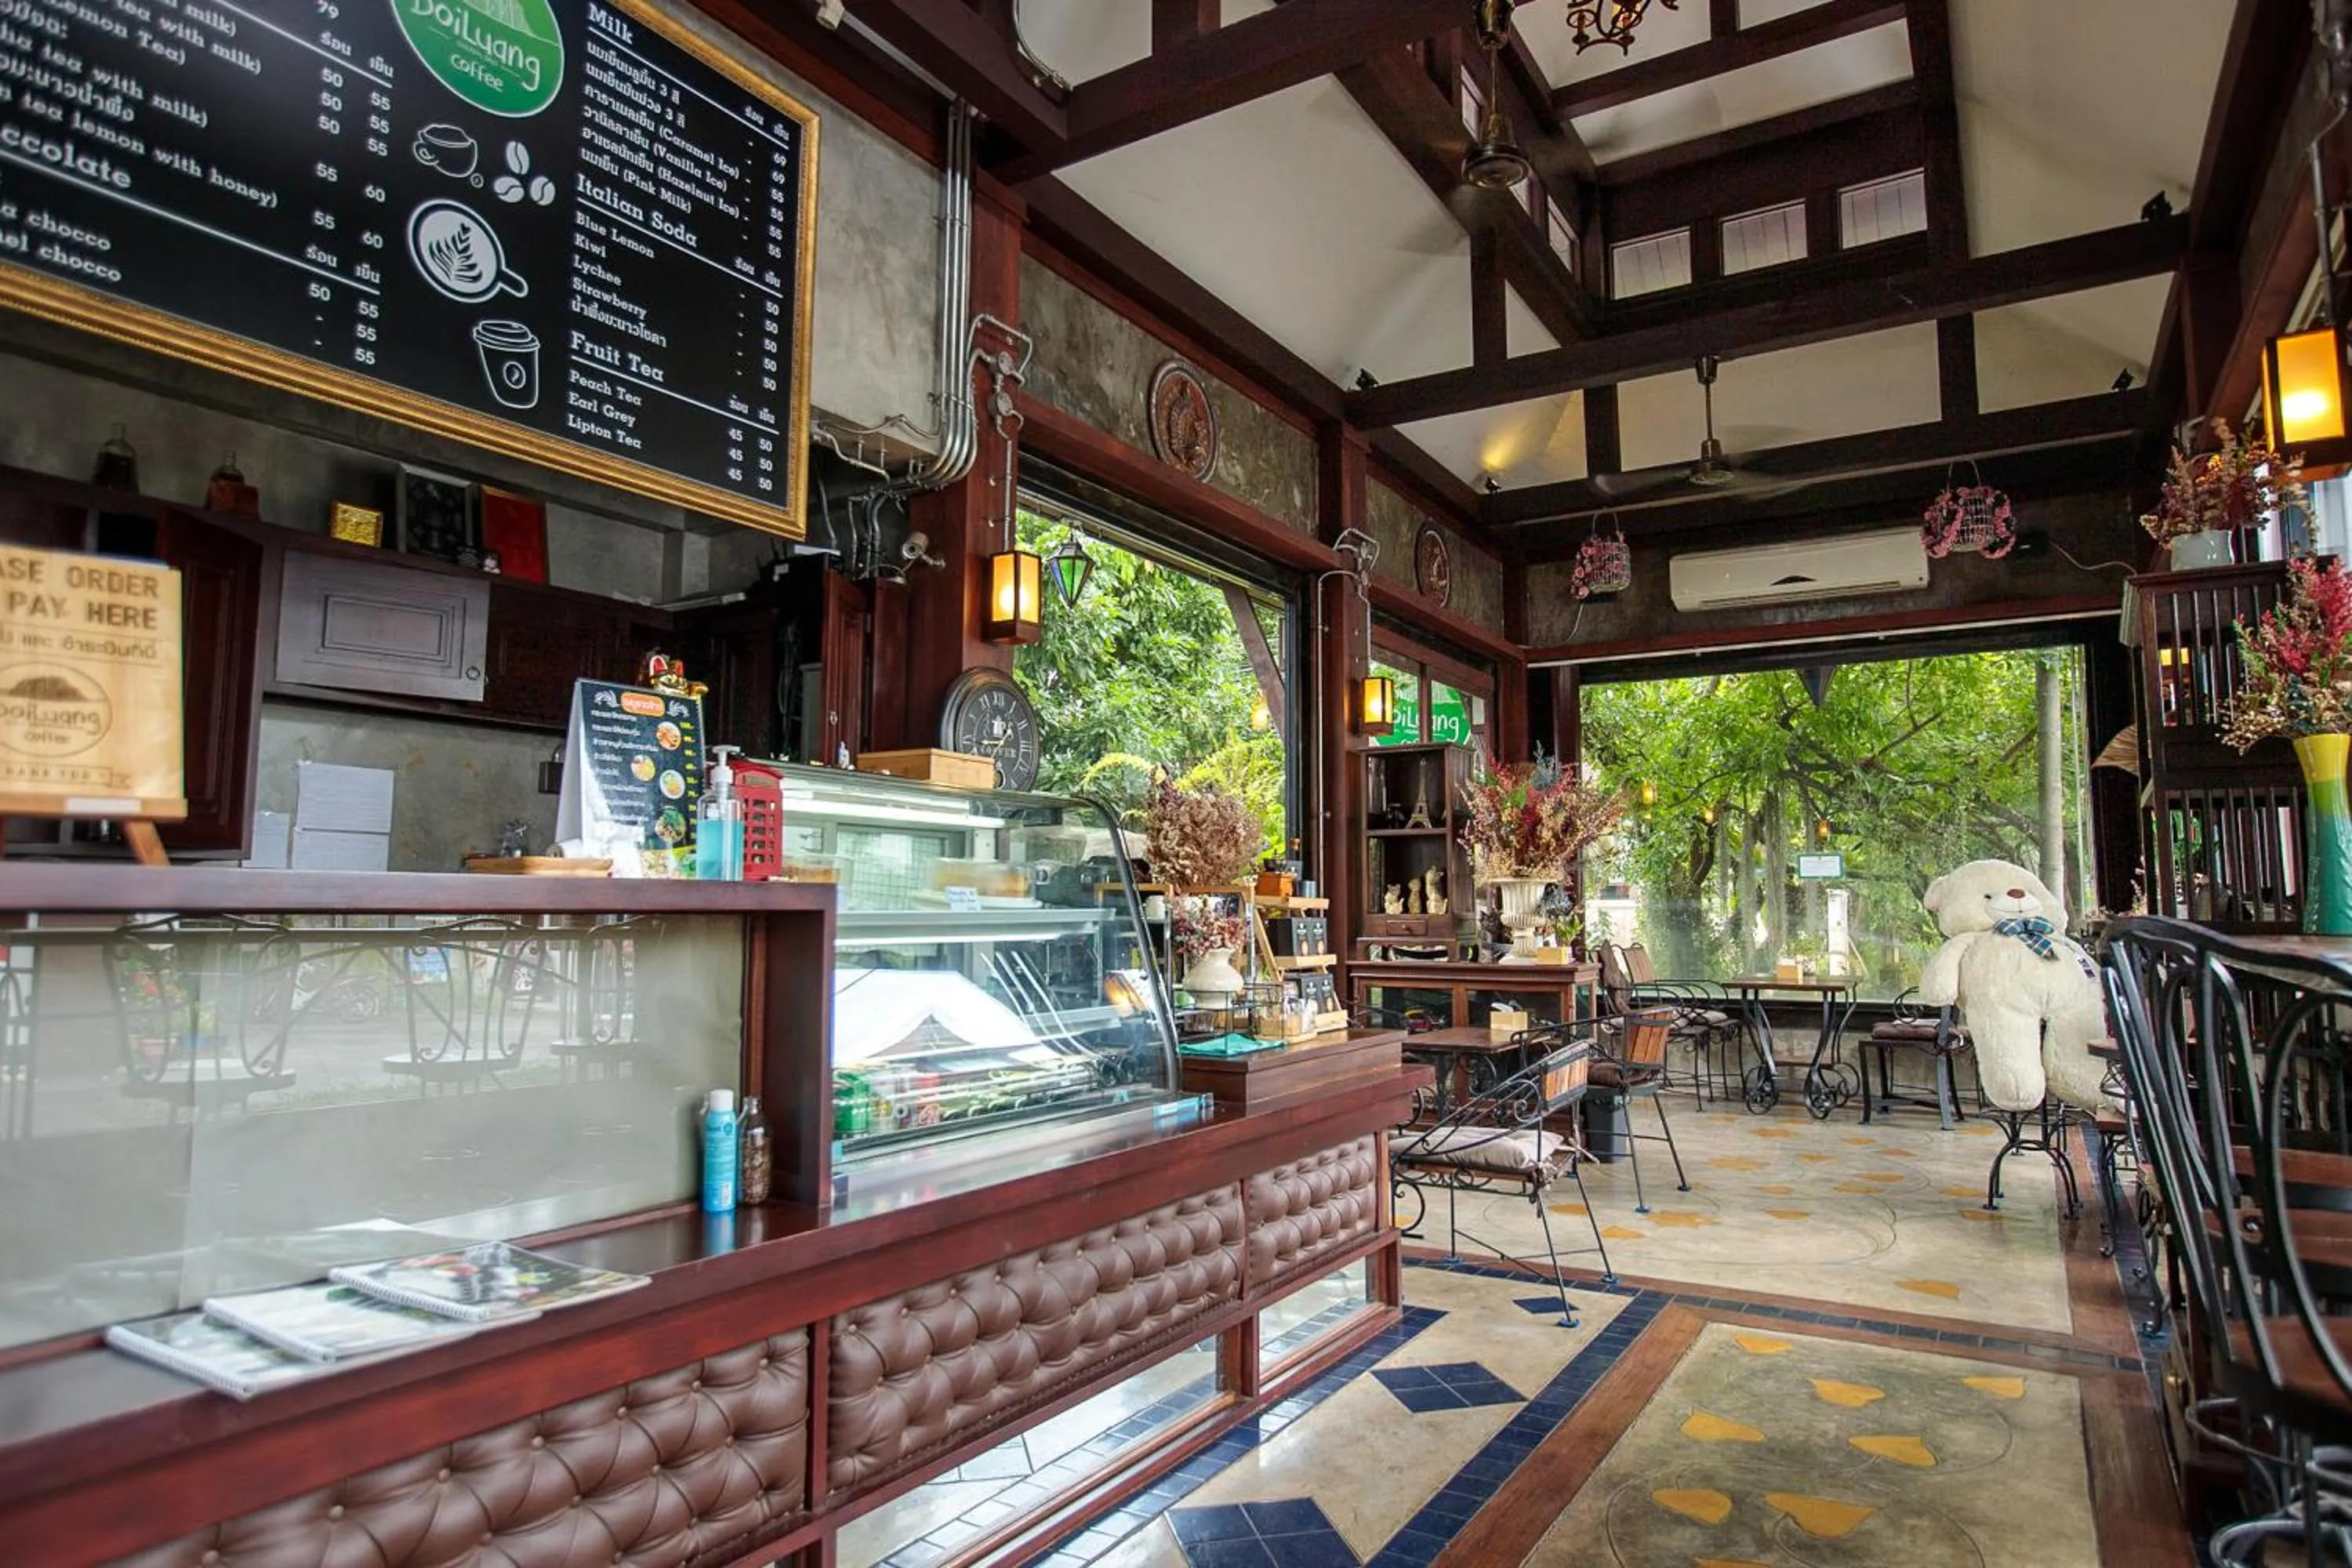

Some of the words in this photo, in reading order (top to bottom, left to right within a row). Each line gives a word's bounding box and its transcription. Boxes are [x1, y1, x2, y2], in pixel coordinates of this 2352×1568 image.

[184, 4, 236, 37] milk)
[589, 2, 633, 44] Milk
[137, 30, 185, 65] Tea)
[158, 16, 205, 48] with
[210, 42, 261, 74] milk)
[93, 68, 143, 100] with
[151, 95, 208, 128] milk)
[321, 67, 343, 87] 50
[371, 92, 390, 111] 55
[659, 84, 667, 96] 3
[321, 92, 342, 111] 50
[370, 115, 389, 133] 55
[666, 108, 673, 120] 3
[319, 115, 339, 134] 50
[368, 138, 387, 156] 55
[72, 111, 145, 154] lemon
[154, 148, 201, 178] with
[209, 166, 278, 208] honey)
[317, 163, 337, 182] 55
[365, 185, 386, 202] 60
[623, 169, 655, 195] (Pink
[659, 188, 691, 213] Milk)
[577, 172, 644, 222] Italian
[652, 212, 697, 247] Soda
[28, 210, 111, 250] chocco
[314, 211, 335, 230] 55
[362, 232, 383, 249] 60
[575, 234, 606, 257] Kiwi
[576, 211, 606, 235] Blue
[612, 228, 655, 259] Lemon
[39, 245, 122, 281] chocco
[573, 254, 621, 285] Lychee
[309, 283, 330, 301] 50
[358, 300, 379, 318] 55
[572, 277, 647, 320] Strawberry
[765, 301, 779, 315] 50
[357, 324, 376, 341] 55
[764, 320, 779, 334] 50
[354, 347, 375, 365] 55
[571, 330, 620, 365] Fruit
[628, 352, 664, 382] Tea
[764, 339, 777, 353] 50
[764, 358, 777, 372] 50
[569, 369, 612, 395] Peach
[616, 387, 641, 405] Tea
[763, 377, 776, 391] 50
[568, 392, 597, 412] Earl
[603, 405, 636, 427] Grey
[568, 414, 612, 439] Lipton
[617, 430, 641, 448] Tea
[728, 428, 742, 441] 45
[759, 438, 772, 452] 50
[729, 448, 743, 461] 45
[760, 458, 772, 471] 50
[728, 468, 742, 481] 45
[759, 477, 772, 491] 50
[66, 565, 159, 597] ORDER
[9, 591, 67, 619] PAY
[88, 602, 157, 630] HERE
